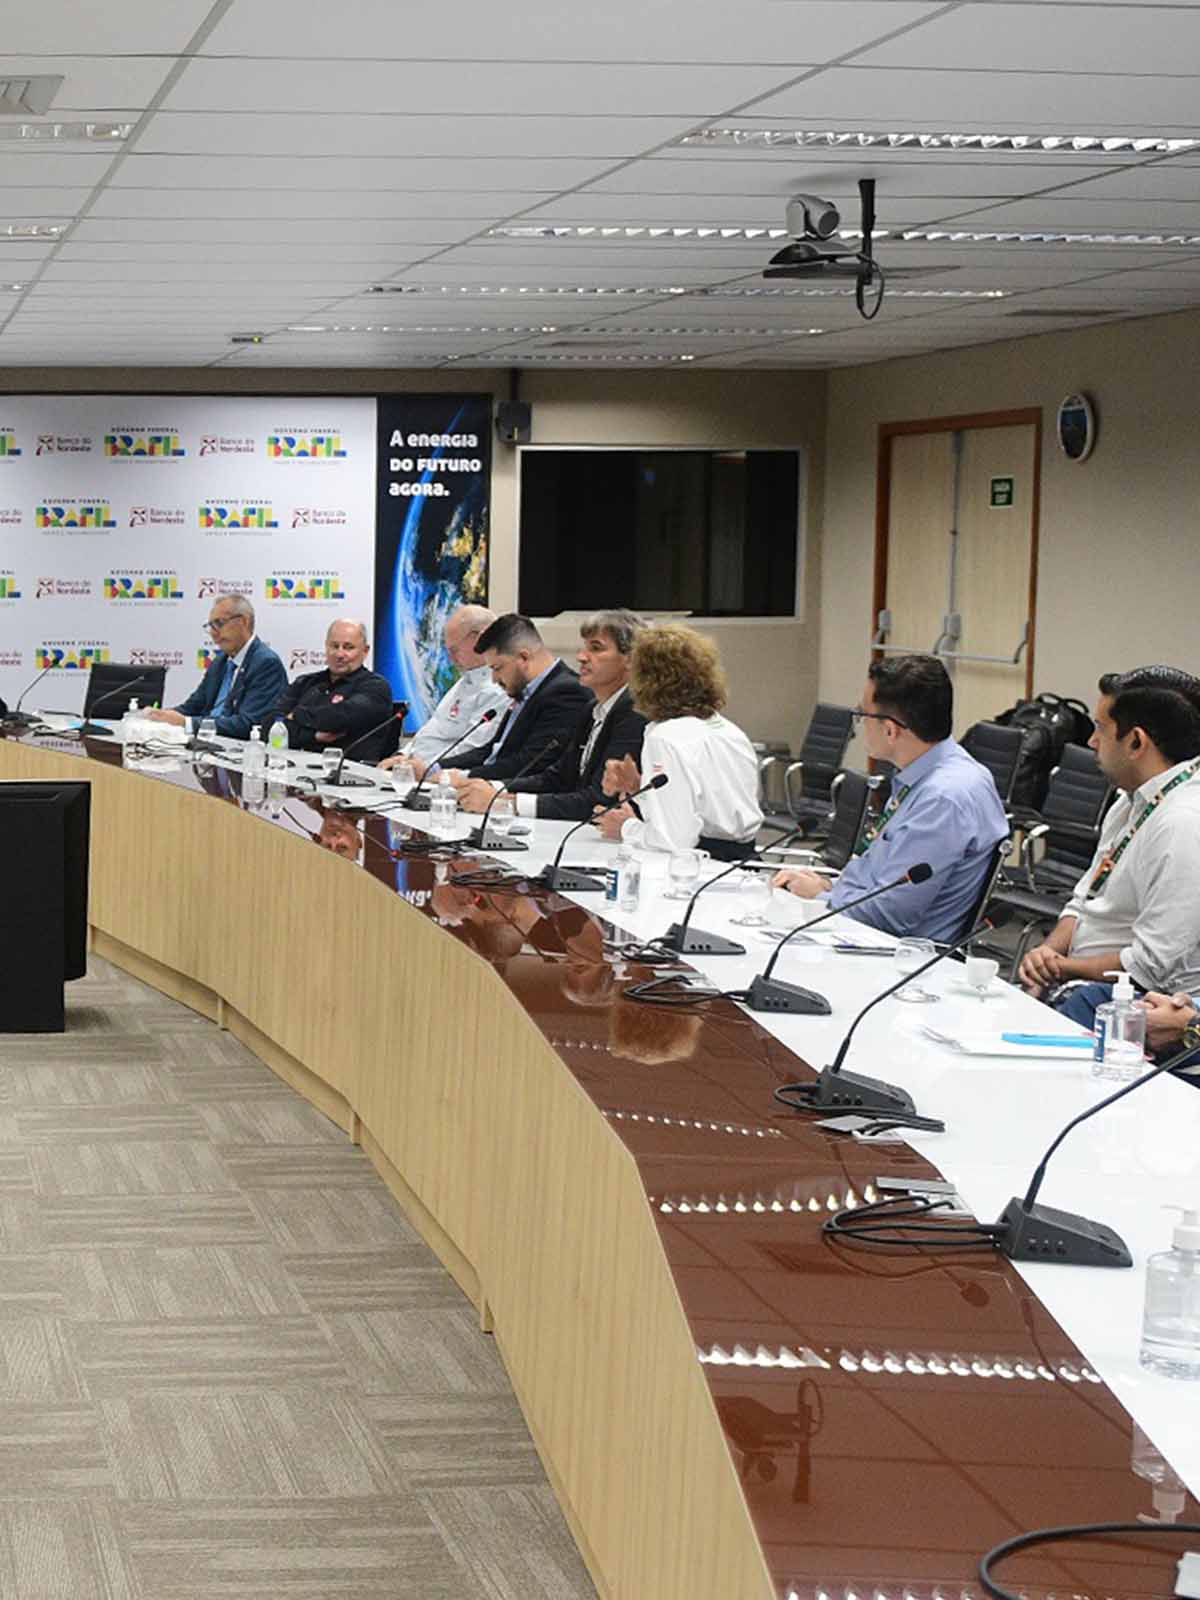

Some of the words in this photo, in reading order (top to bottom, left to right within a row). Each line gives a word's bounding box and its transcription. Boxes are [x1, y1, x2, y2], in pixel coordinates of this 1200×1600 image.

[105, 436, 185, 456] BRASIL
[268, 437, 347, 457] BRASIL
[389, 429, 404, 447] A
[36, 508, 116, 527] BRASIL
[200, 508, 279, 527] BRASIL
[104, 578, 184, 598] BRASIL
[266, 579, 345, 598] BRASIL
